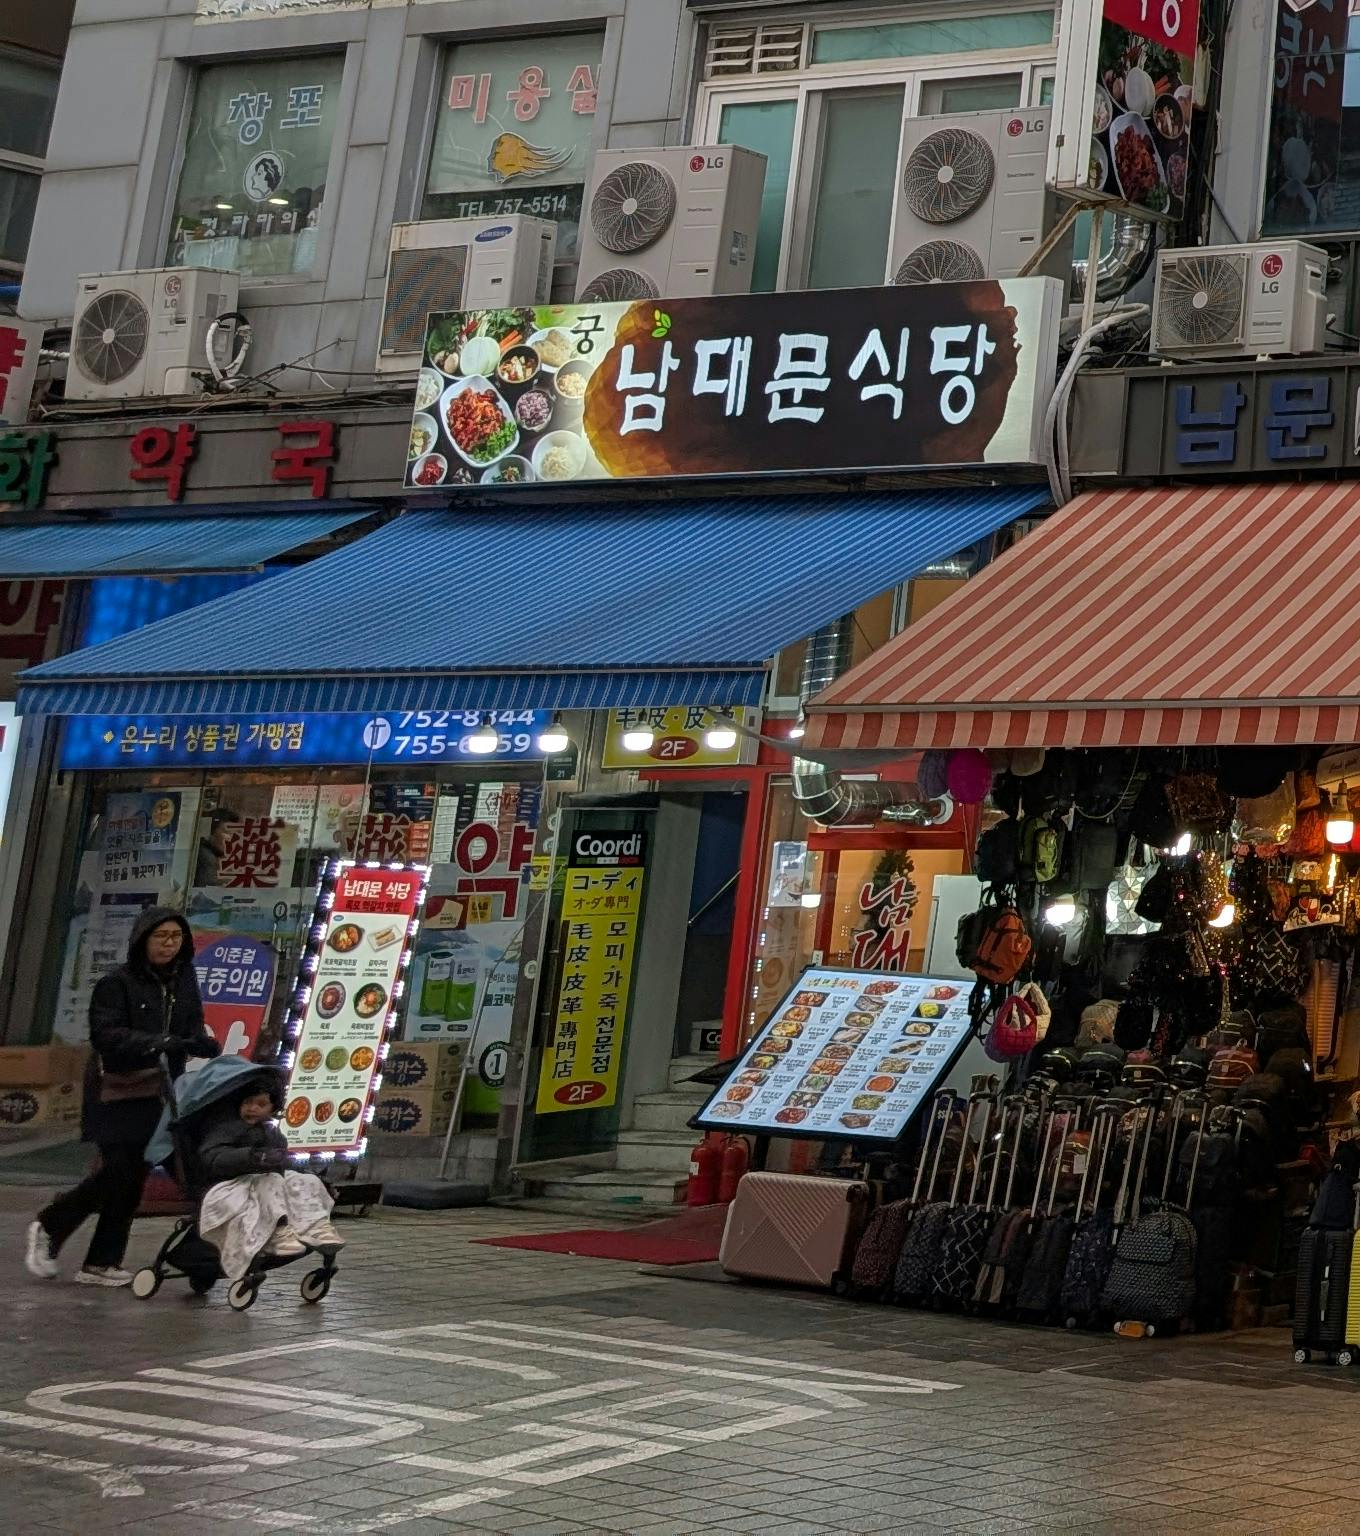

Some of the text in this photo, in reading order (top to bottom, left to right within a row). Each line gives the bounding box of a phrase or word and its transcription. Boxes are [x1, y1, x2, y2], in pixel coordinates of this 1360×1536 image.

[448, 64, 598, 124] 미용실
[227, 84, 324, 146] 창포
[1026, 118, 1045, 133] LG
[706, 157, 724, 171] LG
[1261, 282, 1280, 294] LG
[570, 313, 605, 356] 궁
[615, 321, 998, 437] 남대문식당
[1174, 375, 1335, 464] 남문
[119, 720, 306, 752] 온누리 상품권 가맹점
[660, 741, 686, 757] 2F
[220, 818, 286, 888] 藥
[575, 833, 642, 858] Coordi
[343, 879, 411, 900] 남대문 식당
[568, 1083, 594, 1101] 2F
